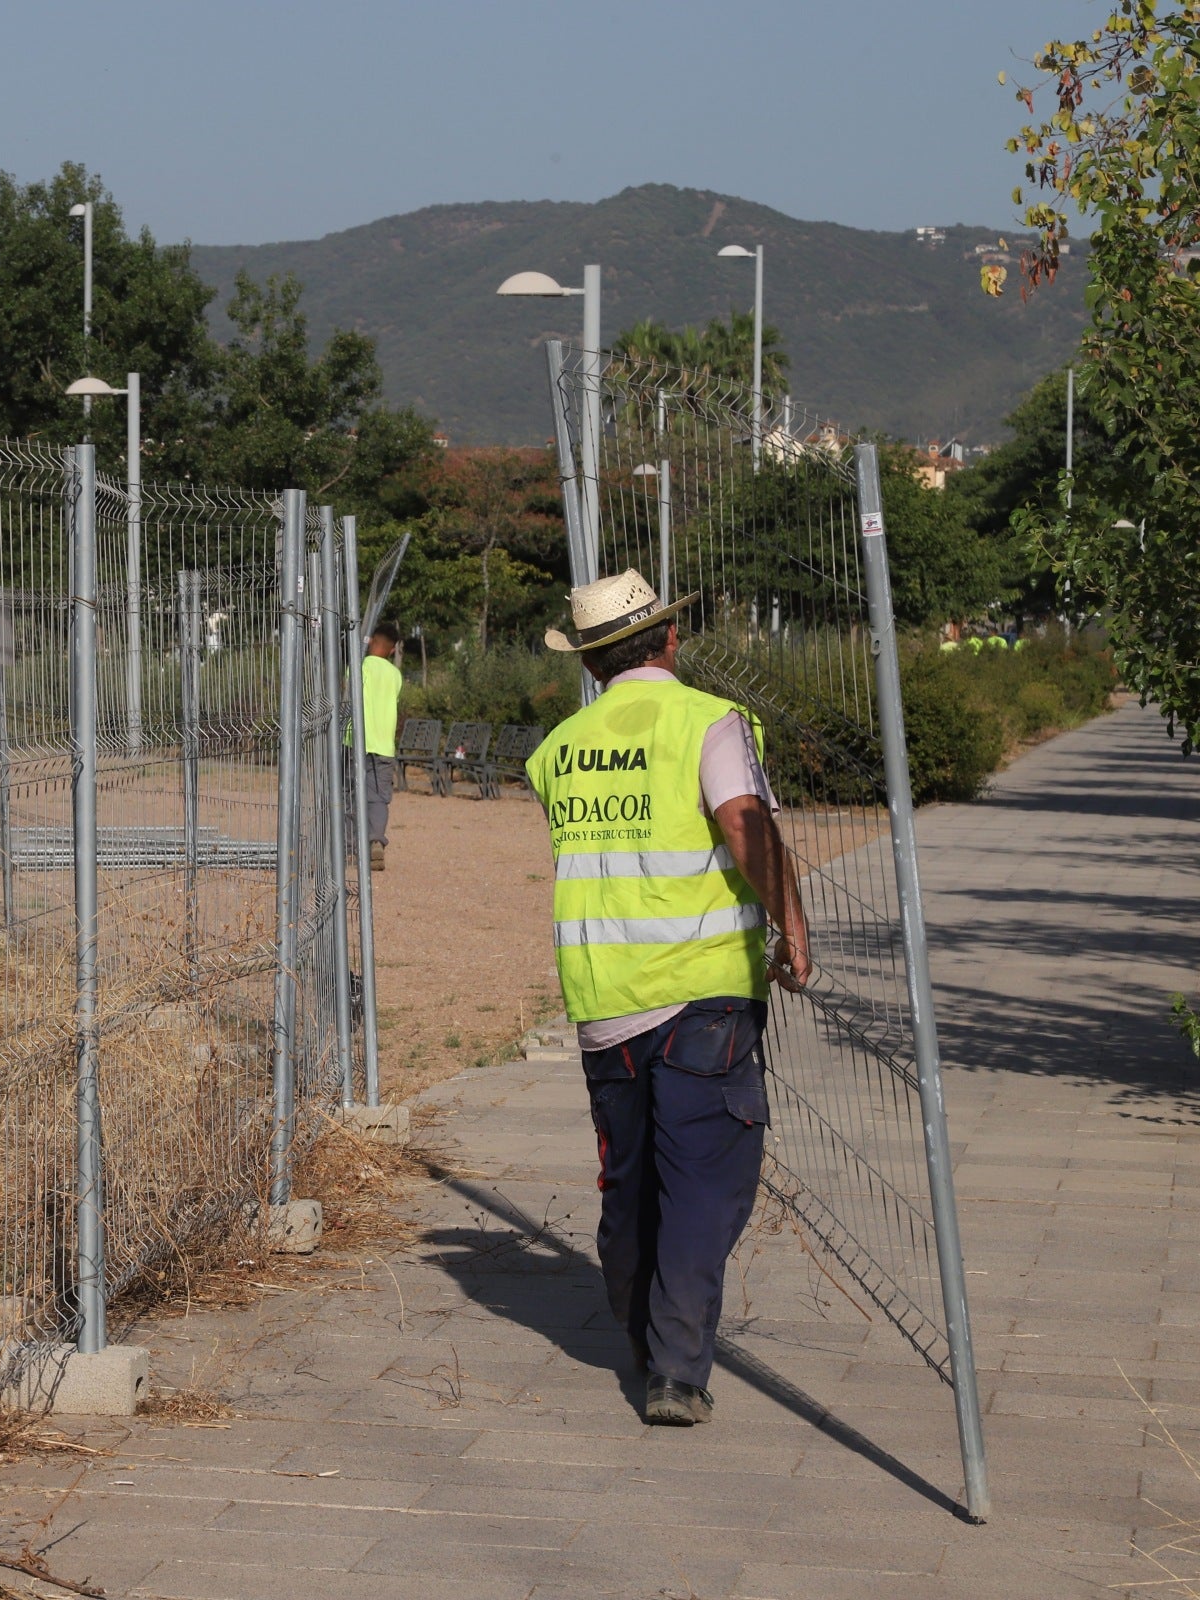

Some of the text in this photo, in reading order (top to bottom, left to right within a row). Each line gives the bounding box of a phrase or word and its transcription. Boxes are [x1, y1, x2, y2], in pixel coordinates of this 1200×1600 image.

[629, 609, 649, 625] RON
[577, 748, 647, 772] ULMA
[582, 830, 589, 841] Y
[590, 828, 652, 841] ESTRUCTURAS
